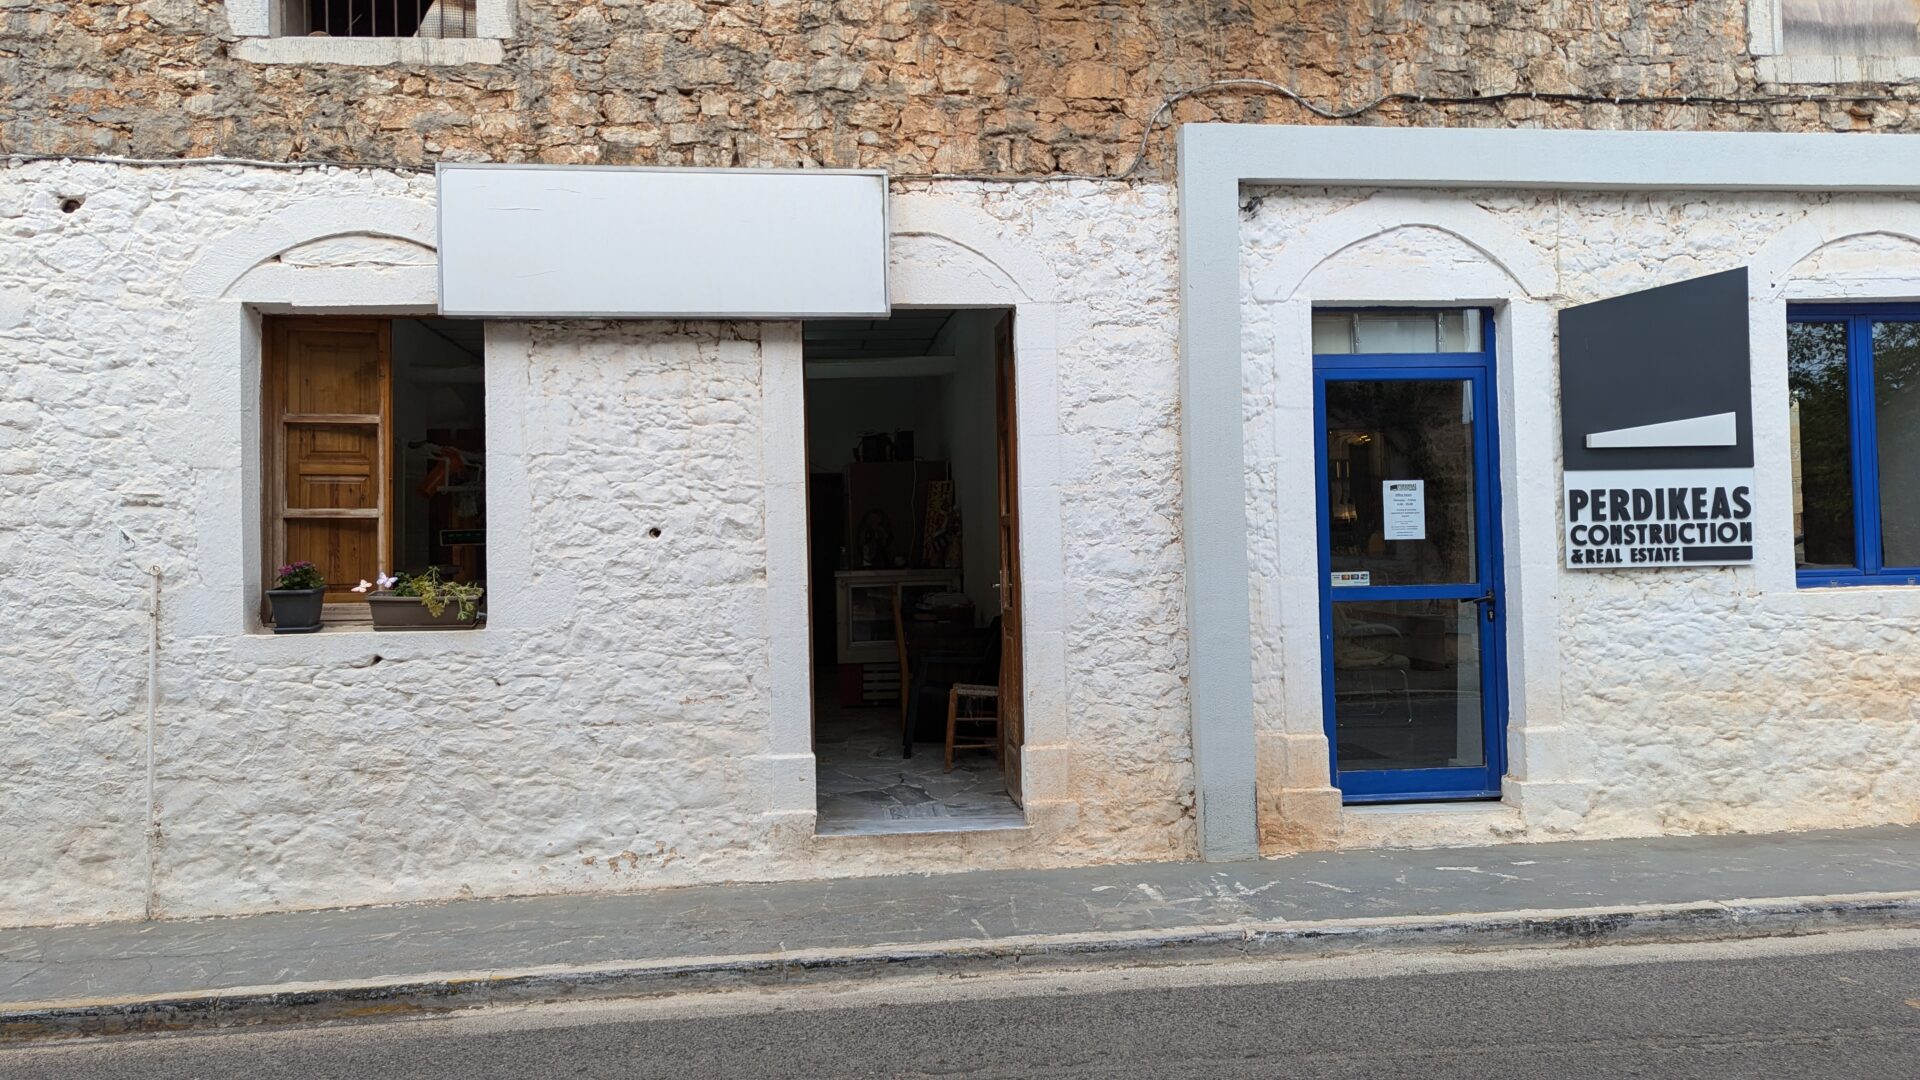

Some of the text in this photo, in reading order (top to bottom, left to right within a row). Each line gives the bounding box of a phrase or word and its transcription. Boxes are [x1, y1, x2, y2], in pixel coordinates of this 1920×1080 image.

[1569, 486, 1752, 522] PERDIKEAS
[1570, 522, 1753, 546] CONSTRUCTION
[1630, 547, 1681, 562] ESTATE
